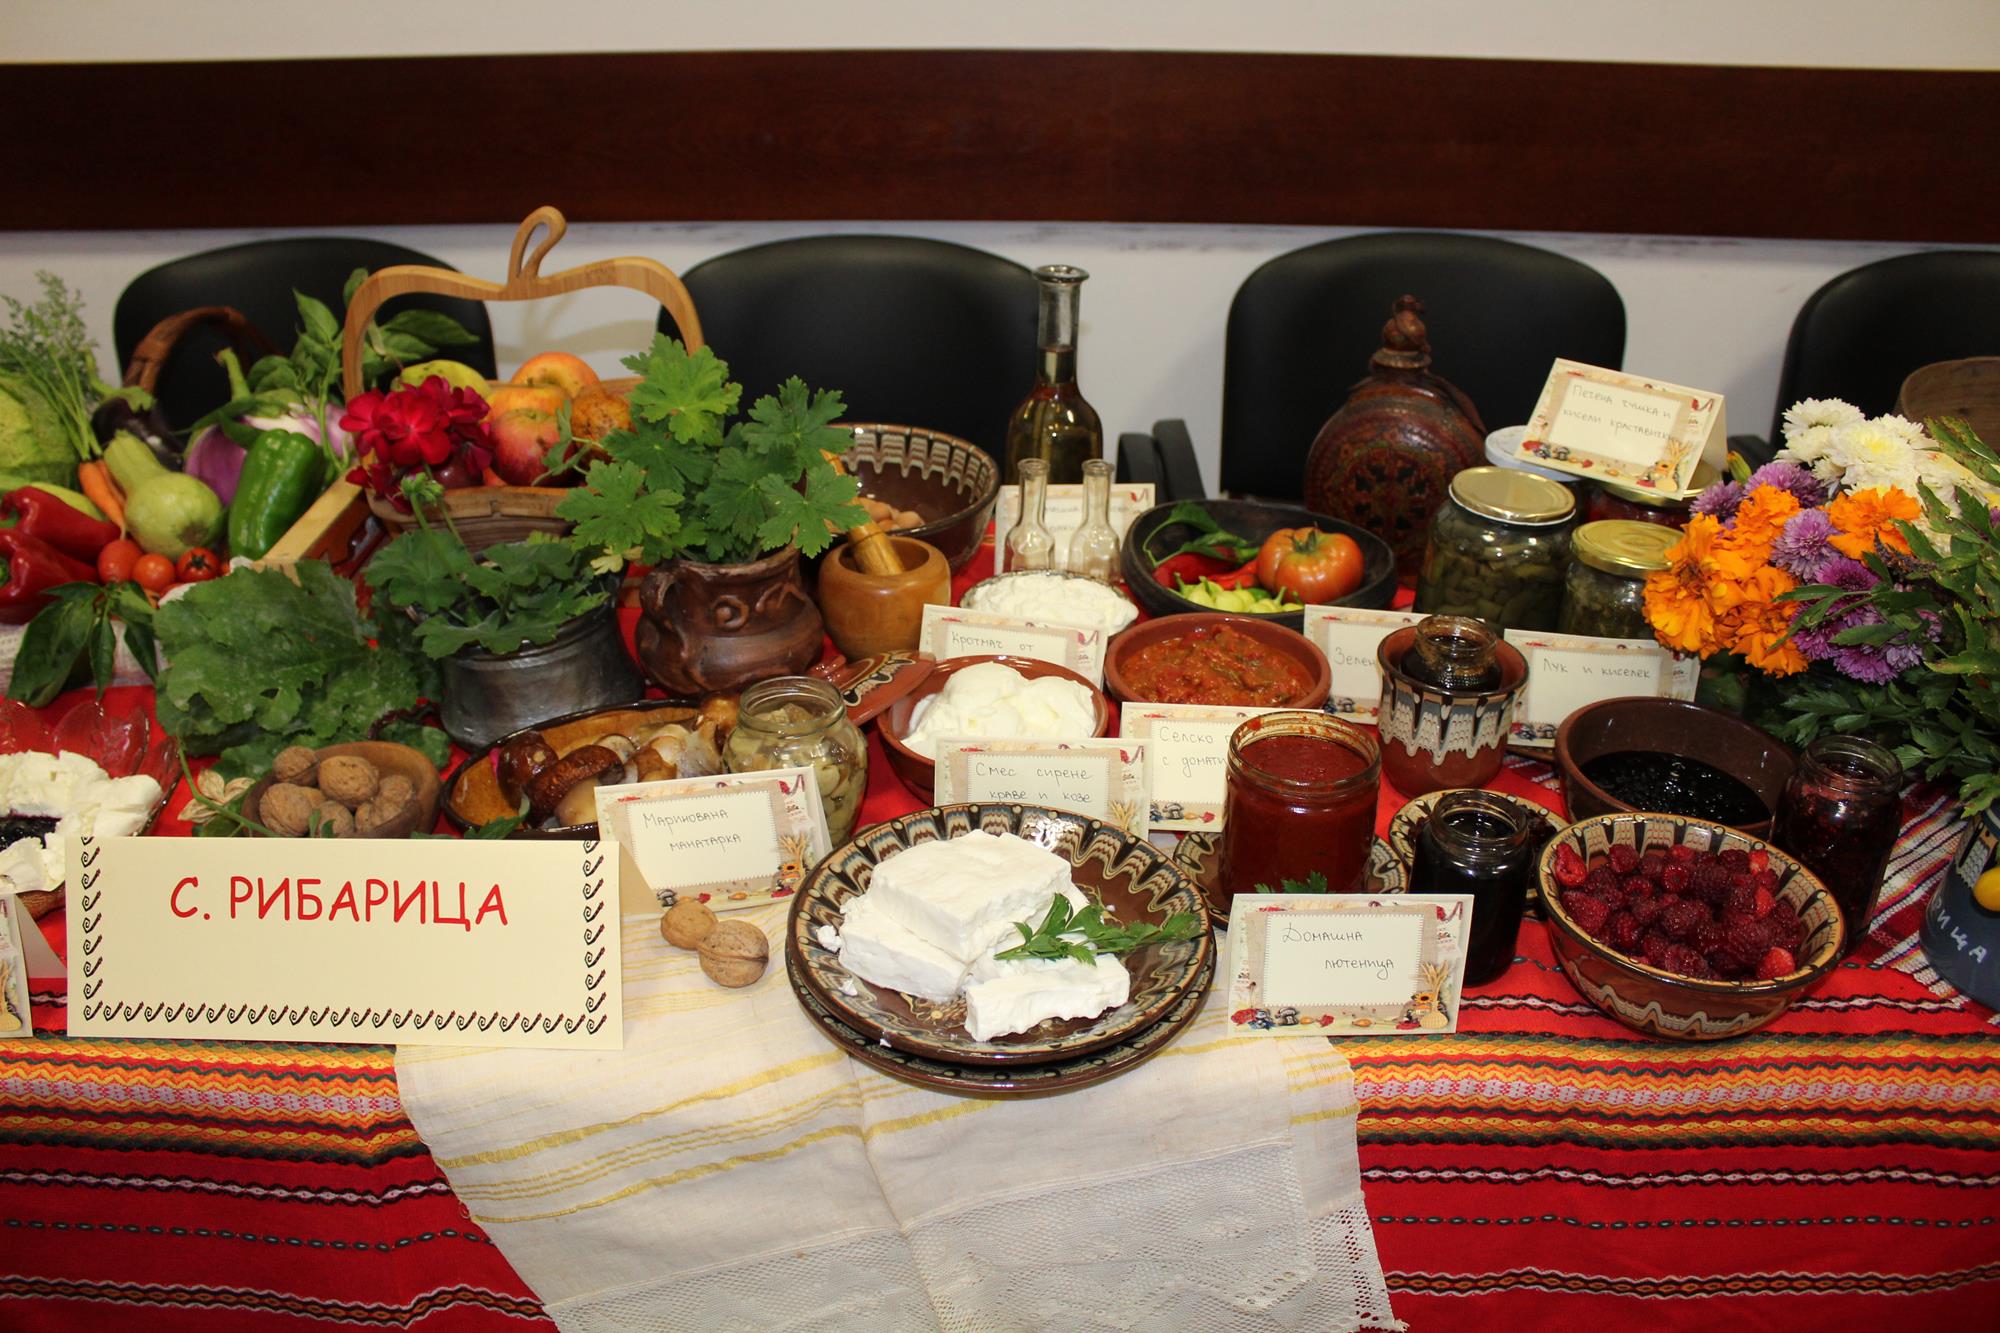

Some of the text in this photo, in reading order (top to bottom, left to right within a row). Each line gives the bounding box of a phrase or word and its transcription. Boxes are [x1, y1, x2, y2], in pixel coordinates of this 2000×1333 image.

[1019, 643, 1034, 652] от
[1543, 658, 1569, 674] Лук
[1601, 667, 1651, 679] киселек
[1159, 726, 1214, 744] Селско
[975, 762, 1095, 786] Смес сирене
[989, 790, 1093, 803] краве и козе
[643, 808, 730, 836] Маринована
[669, 833, 743, 854] манатарка
[230, 876, 509, 933] РИБАРИЦА
[1281, 921, 1366, 944] Домашна
[1324, 958, 1396, 981] лютеница
